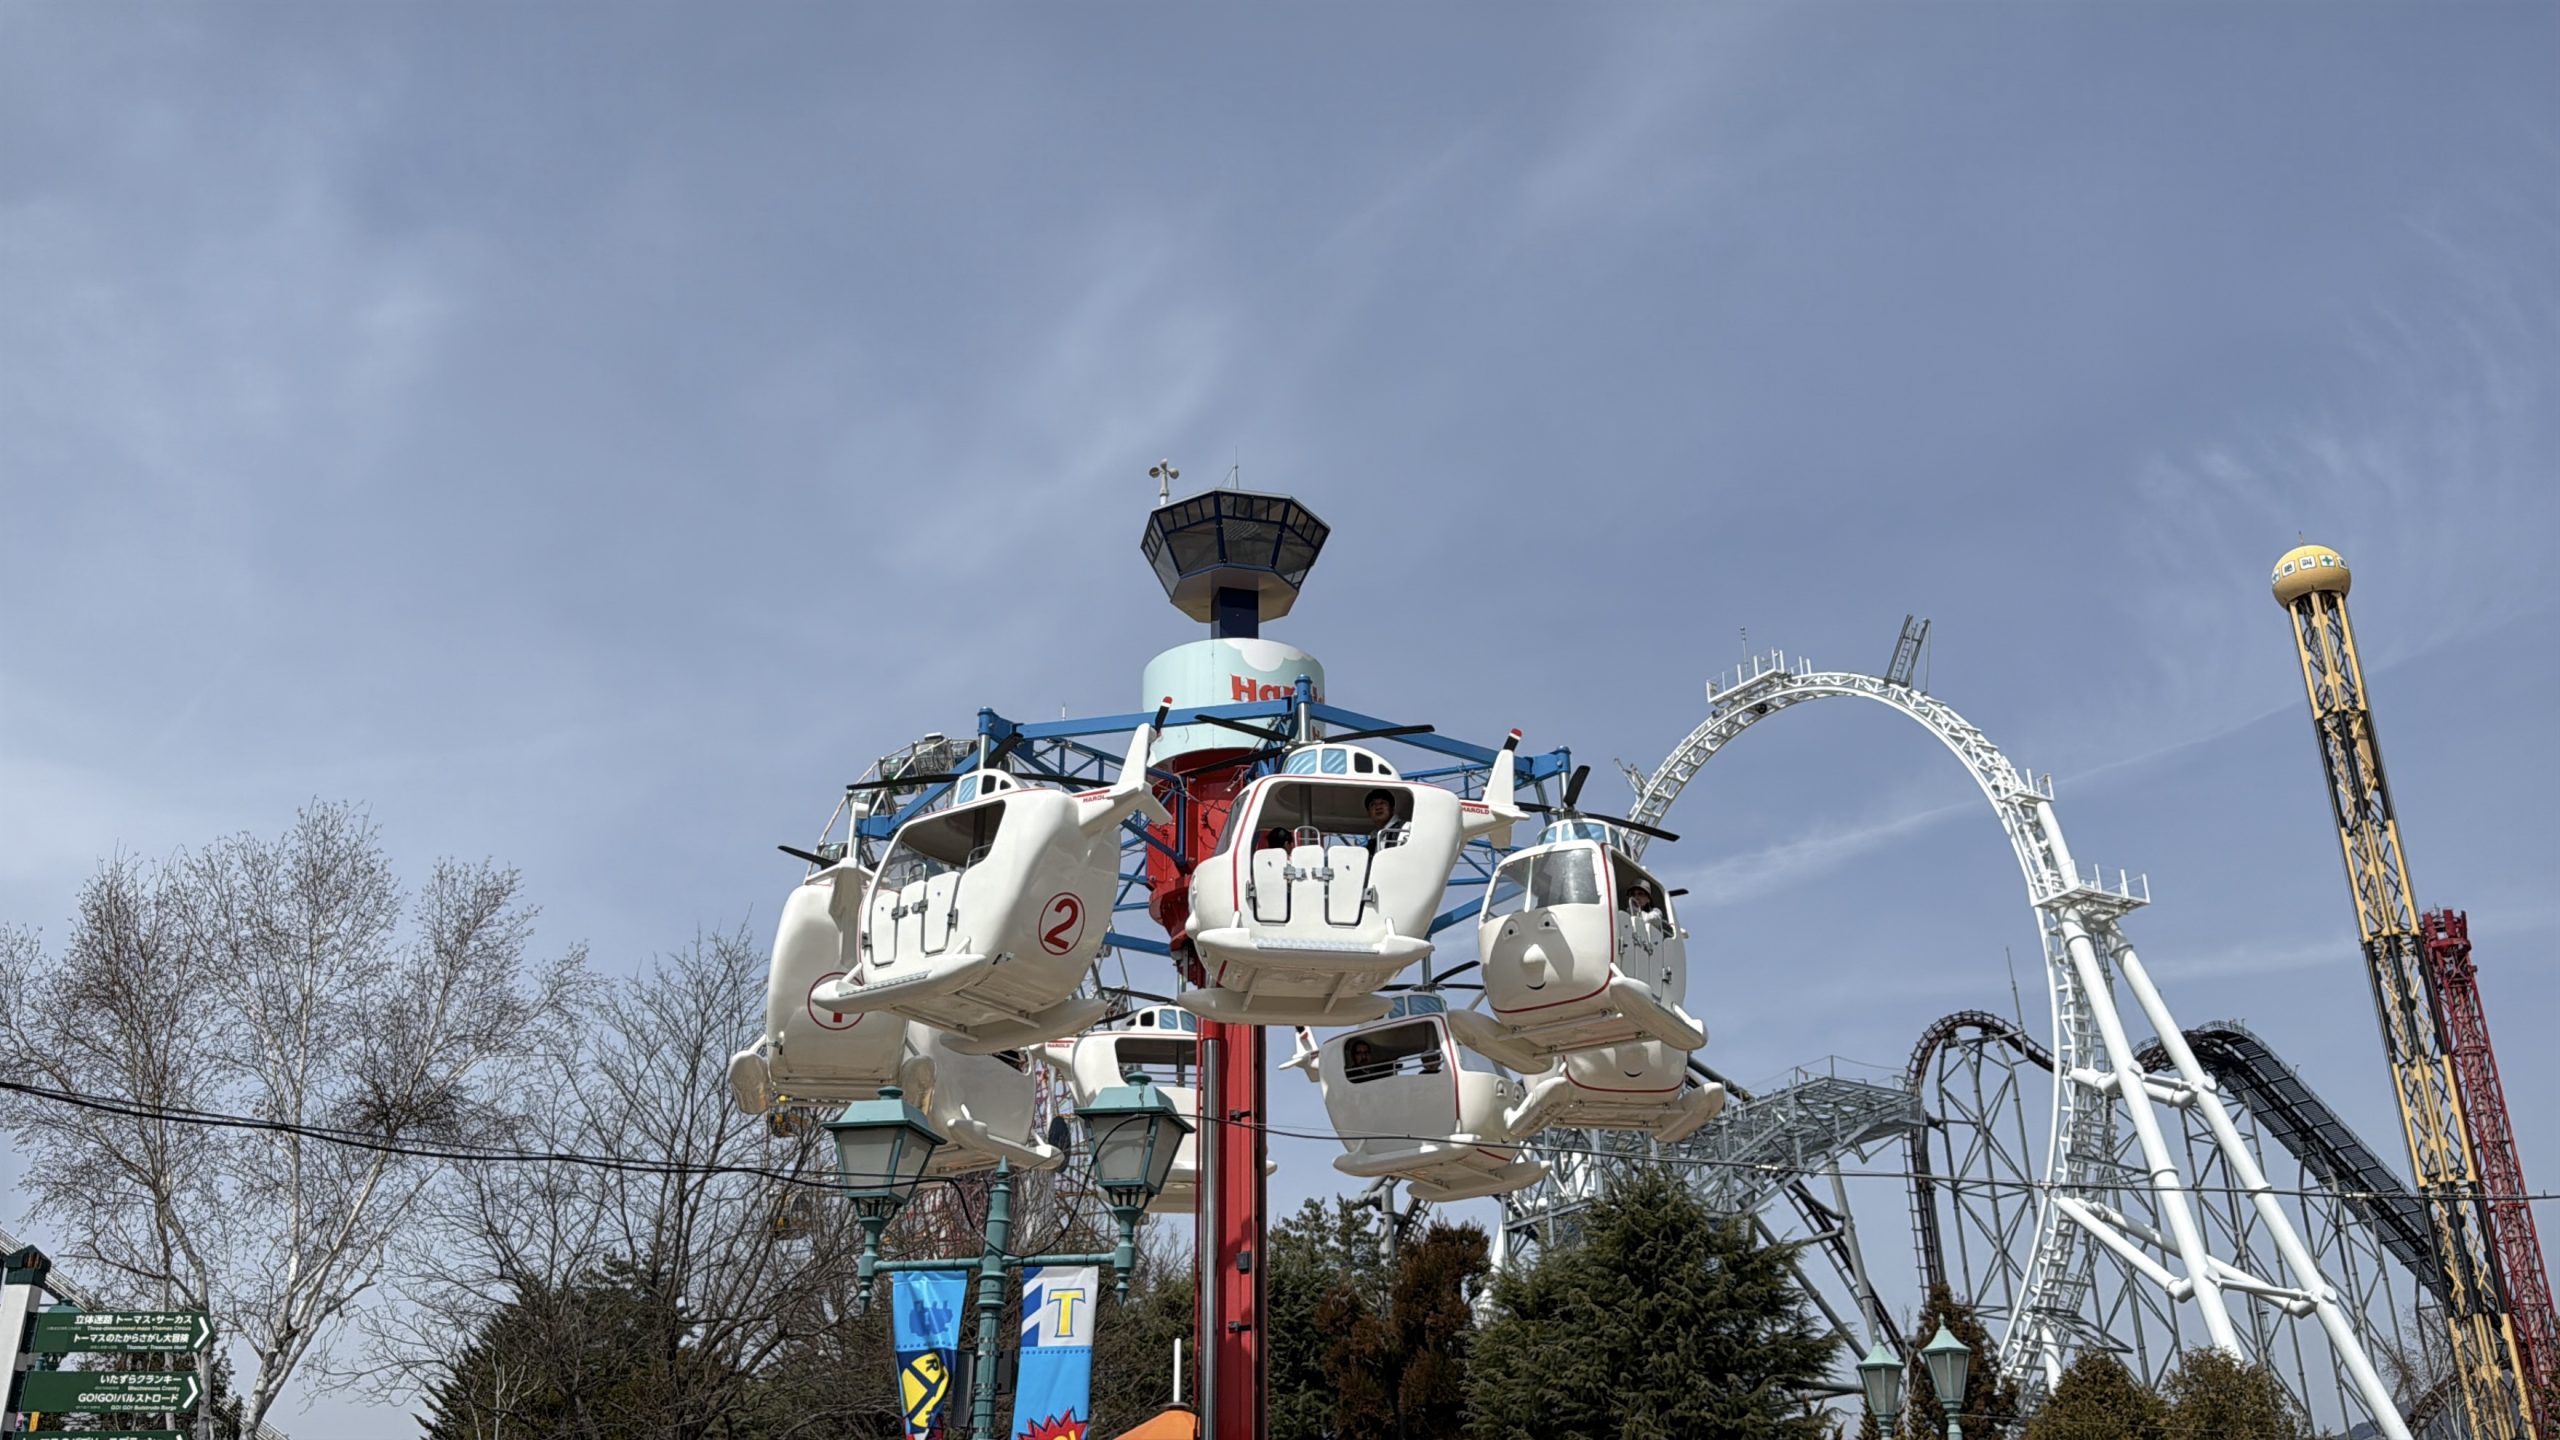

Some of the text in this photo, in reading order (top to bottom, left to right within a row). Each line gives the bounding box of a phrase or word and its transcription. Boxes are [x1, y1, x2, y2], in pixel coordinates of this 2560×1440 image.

[1044, 898, 1078, 950] 2
[1047, 1288, 1086, 1338] T
[100, 1374, 182, 1385] いたずらクランキー
